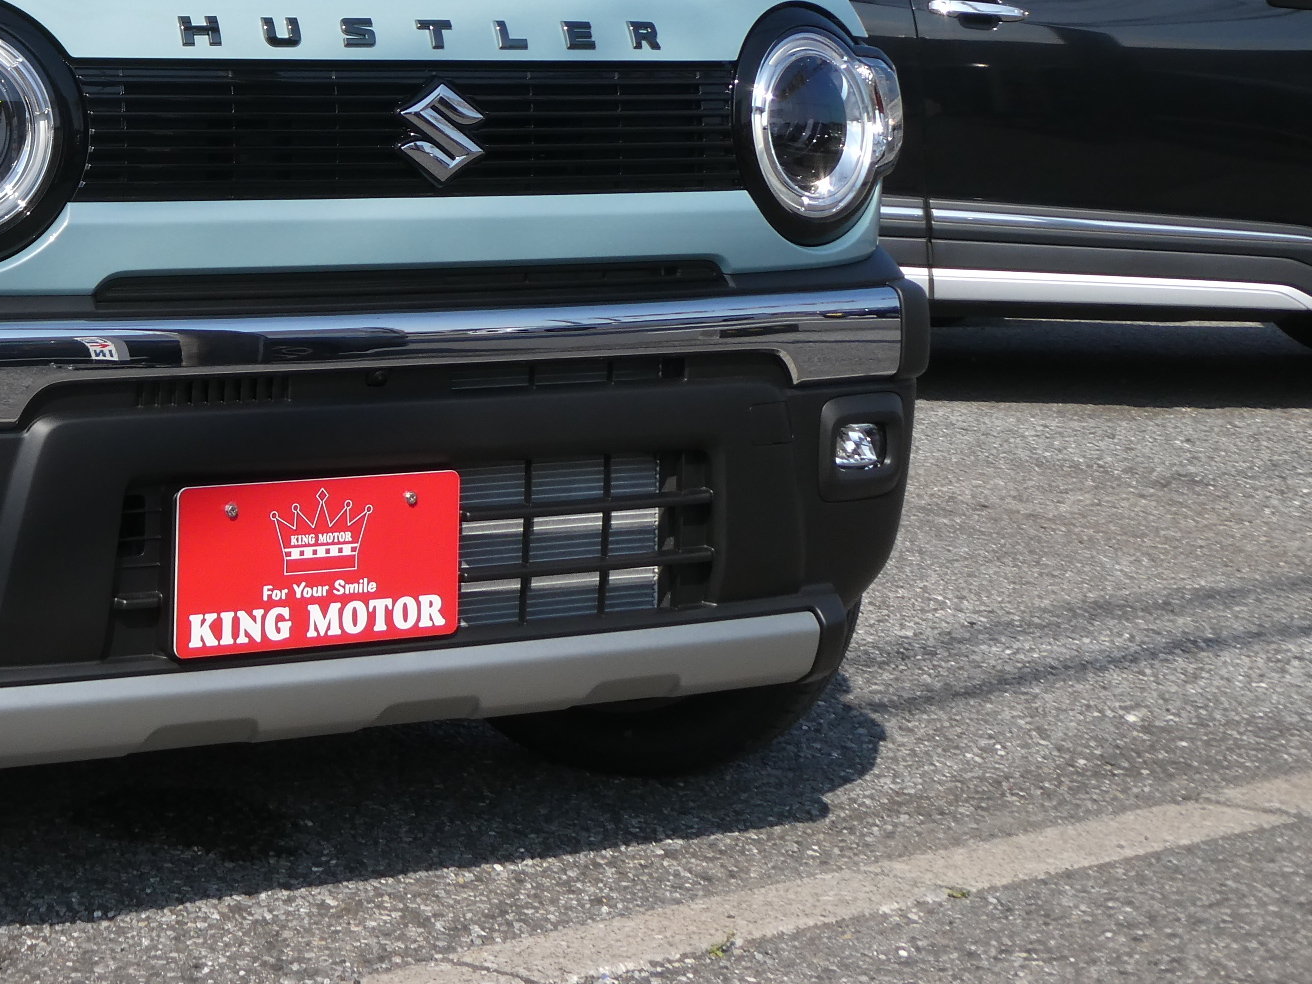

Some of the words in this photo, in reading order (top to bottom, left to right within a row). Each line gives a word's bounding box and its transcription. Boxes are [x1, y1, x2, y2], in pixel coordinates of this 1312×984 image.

[177, 15, 662, 51] HUSTLER
[290, 534, 316, 546] KING
[318, 531, 353, 544] MOTOR
[262, 584, 289, 602] For
[292, 580, 330, 599] Your
[332, 577, 377, 596] Smile
[188, 606, 292, 649] KING
[306, 594, 446, 638] MOTOR
